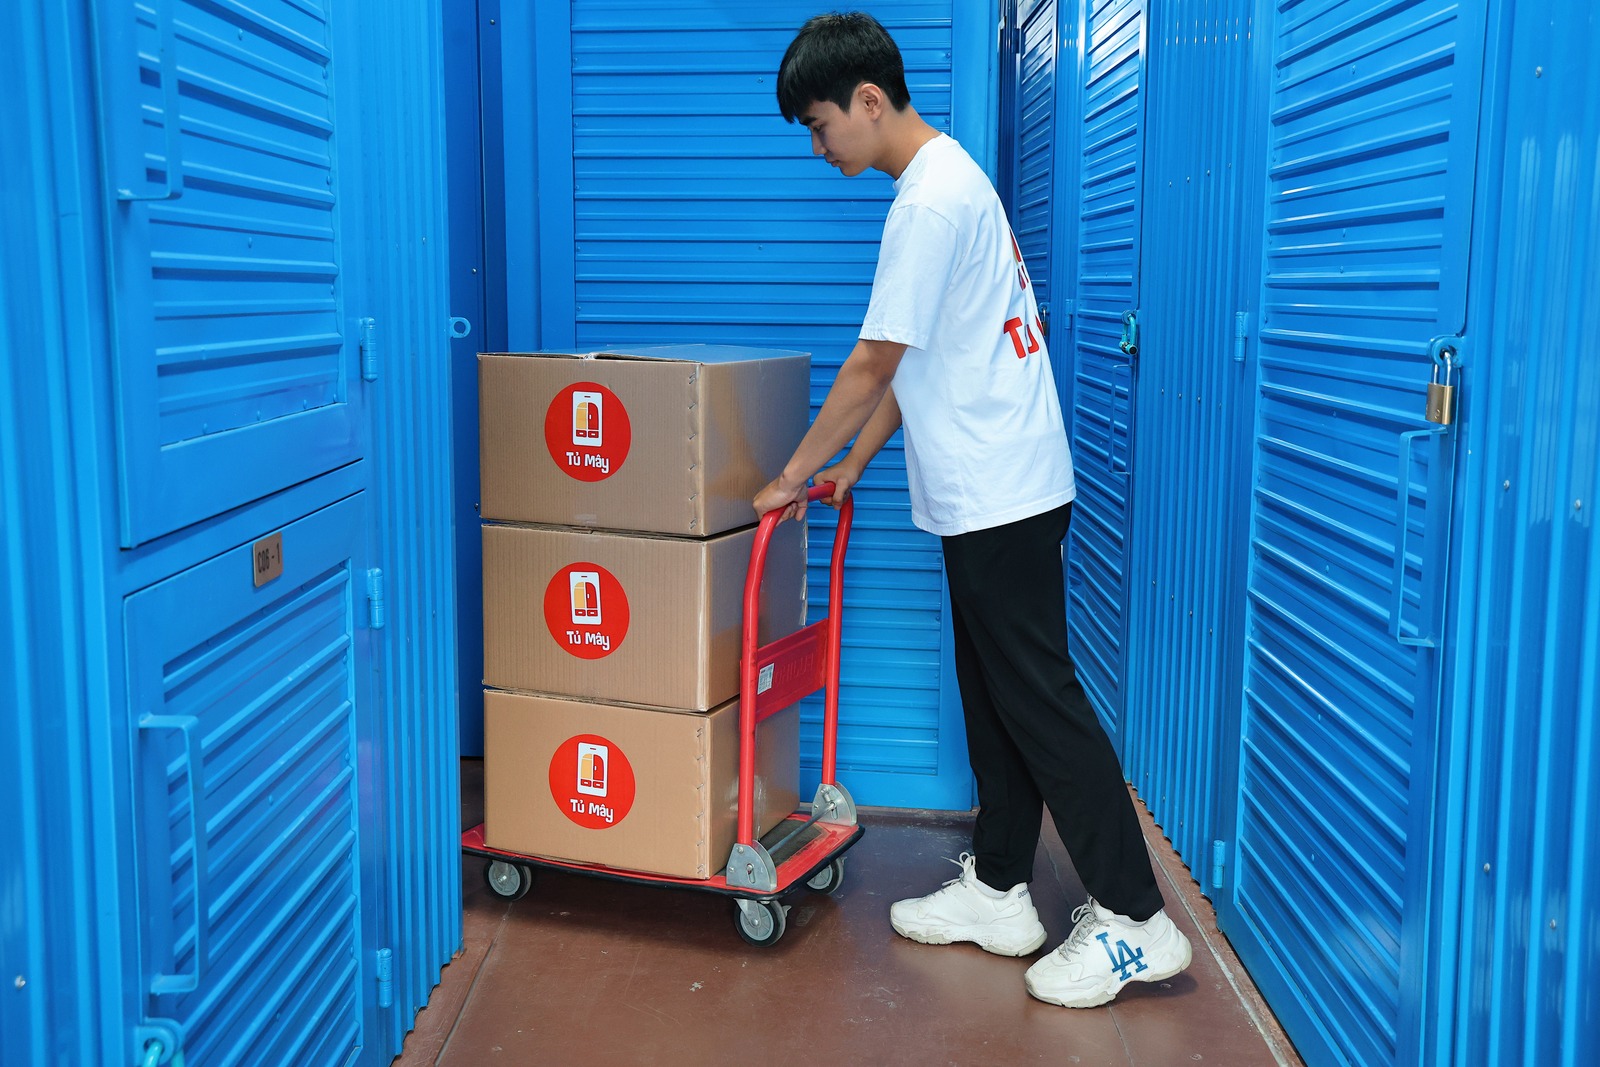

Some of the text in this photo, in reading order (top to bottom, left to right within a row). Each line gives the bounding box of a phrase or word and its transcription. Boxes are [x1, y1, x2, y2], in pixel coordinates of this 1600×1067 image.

[566, 451, 610, 474] Tủ Mây
[566, 630, 611, 651] Tủ Mây
[570, 798, 614, 823] Tủ Mây
[1095, 931, 1148, 982] LA
